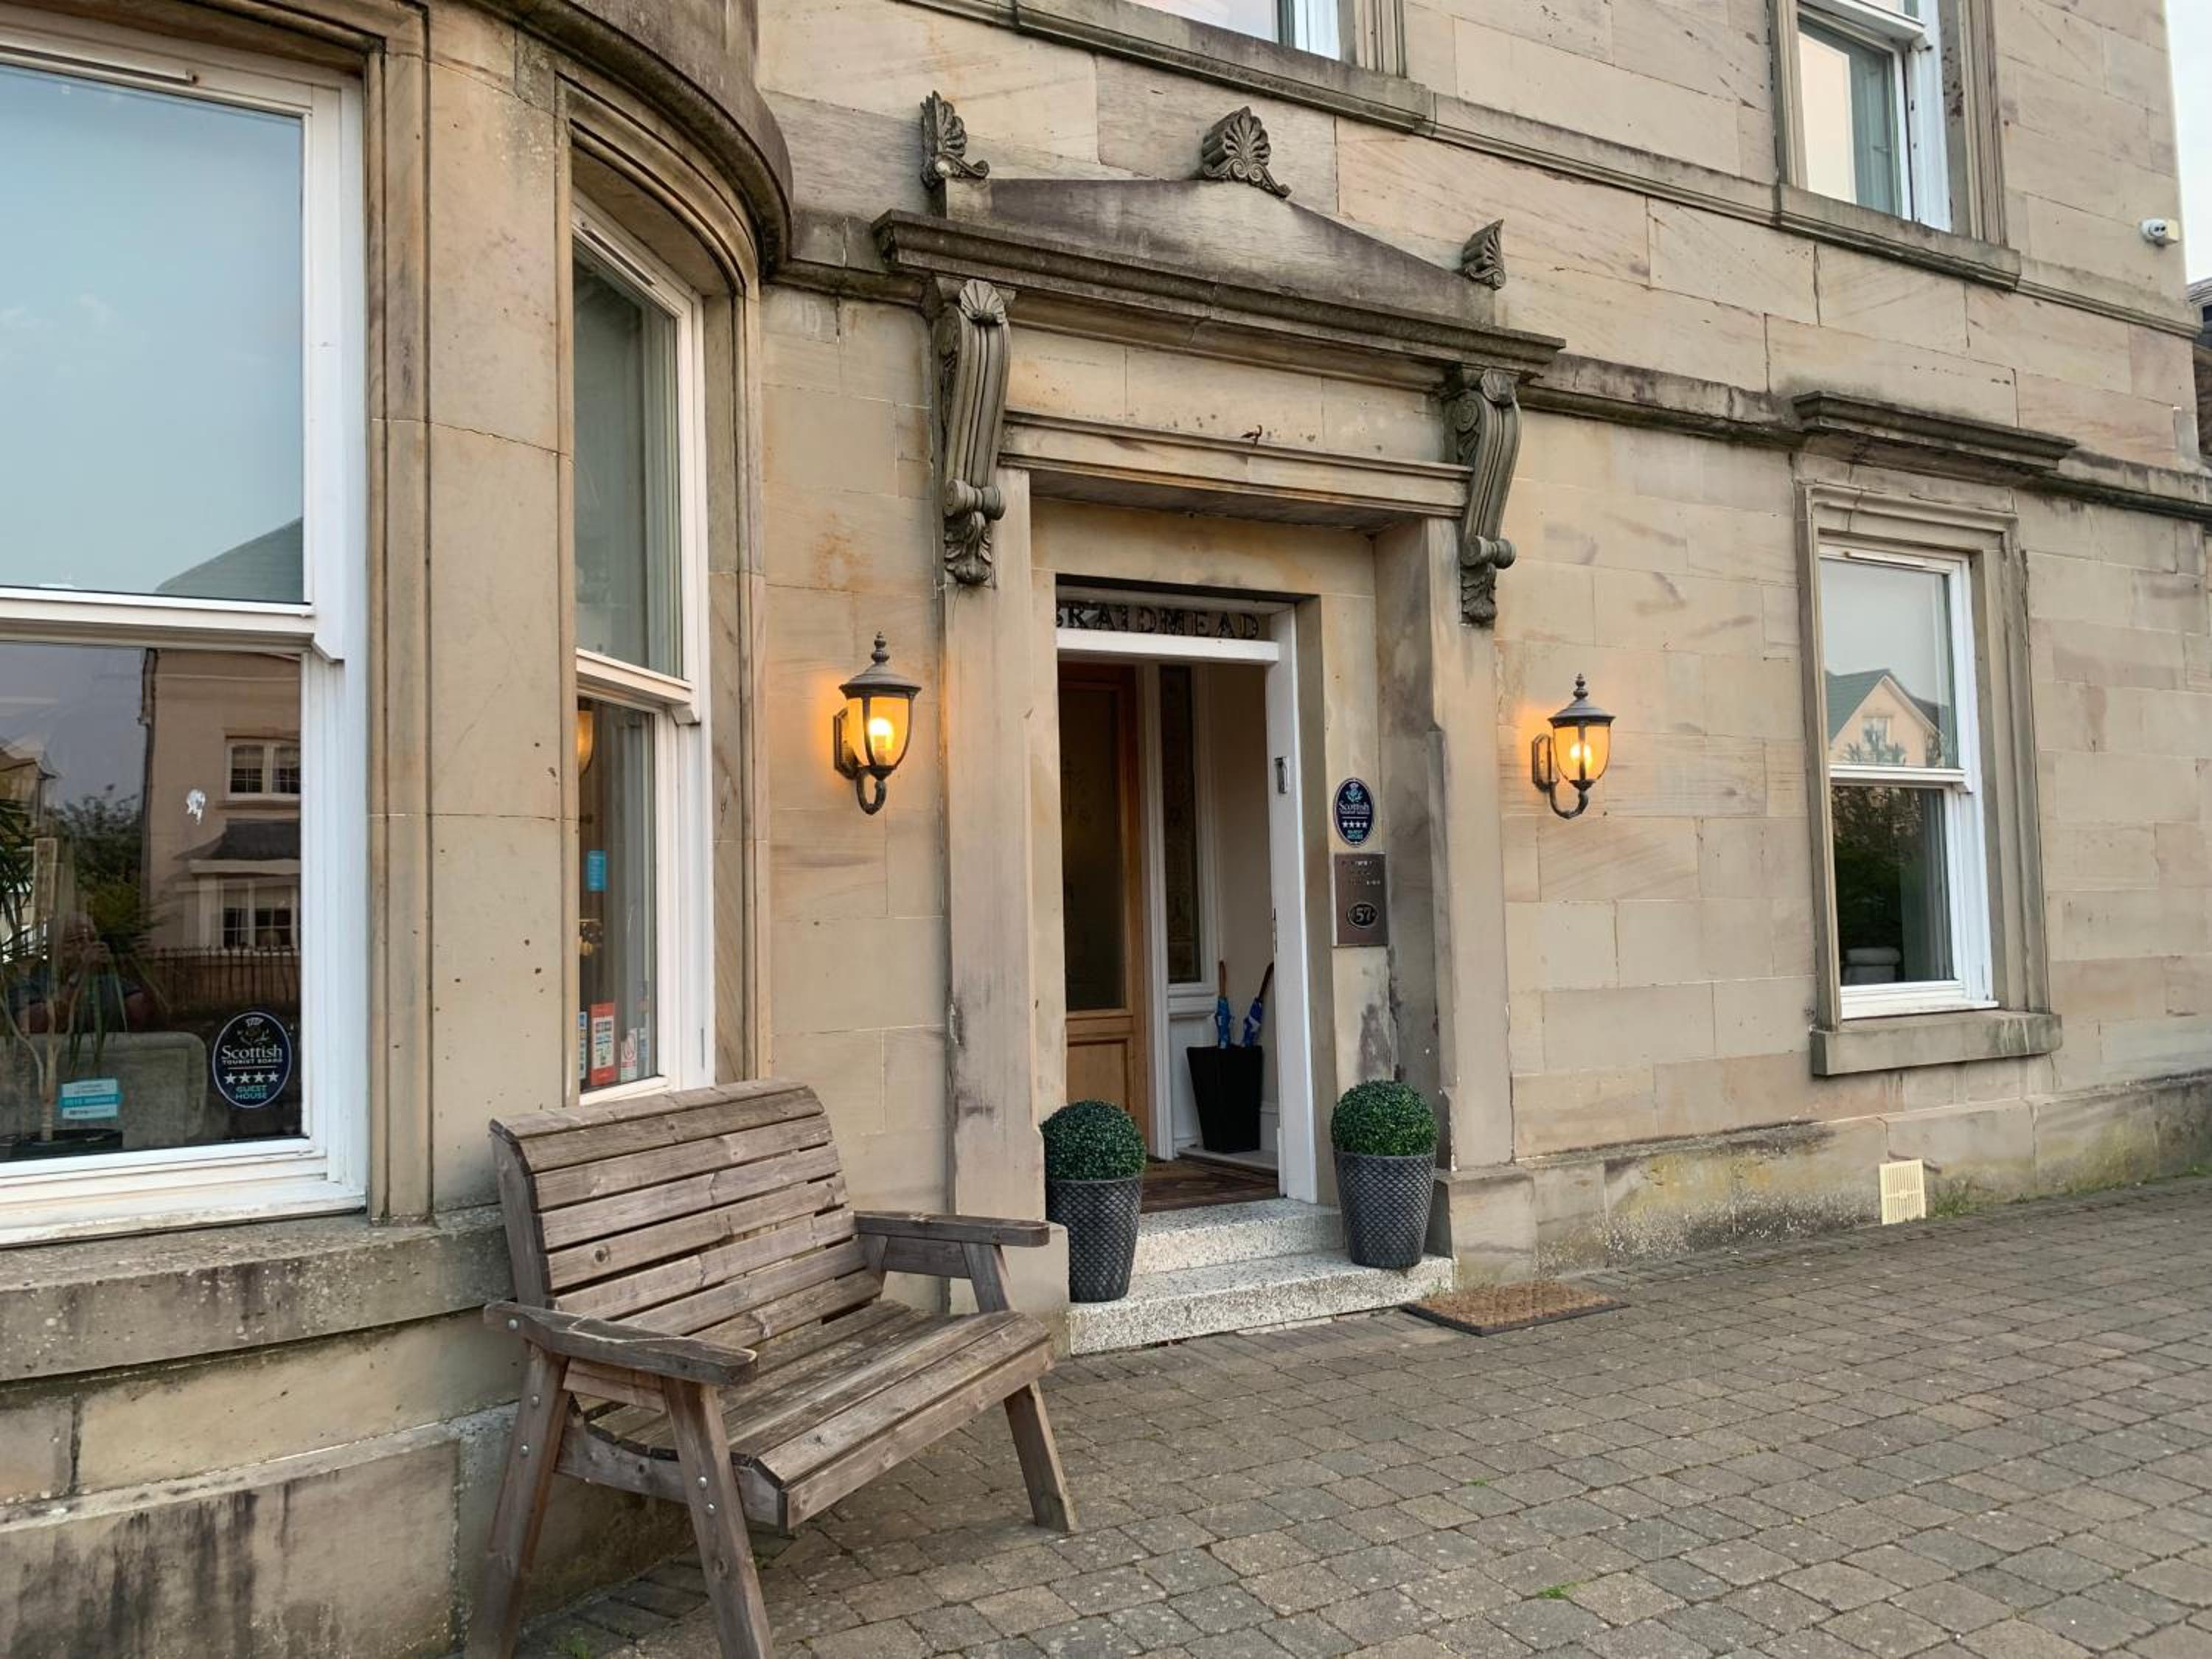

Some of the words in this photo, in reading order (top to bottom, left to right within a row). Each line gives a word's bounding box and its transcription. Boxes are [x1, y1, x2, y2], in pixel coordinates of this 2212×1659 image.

[1338, 801, 1370, 811] Scottish
[1355, 908, 1371, 922] 57
[222, 1044, 282, 1059] Scottish
